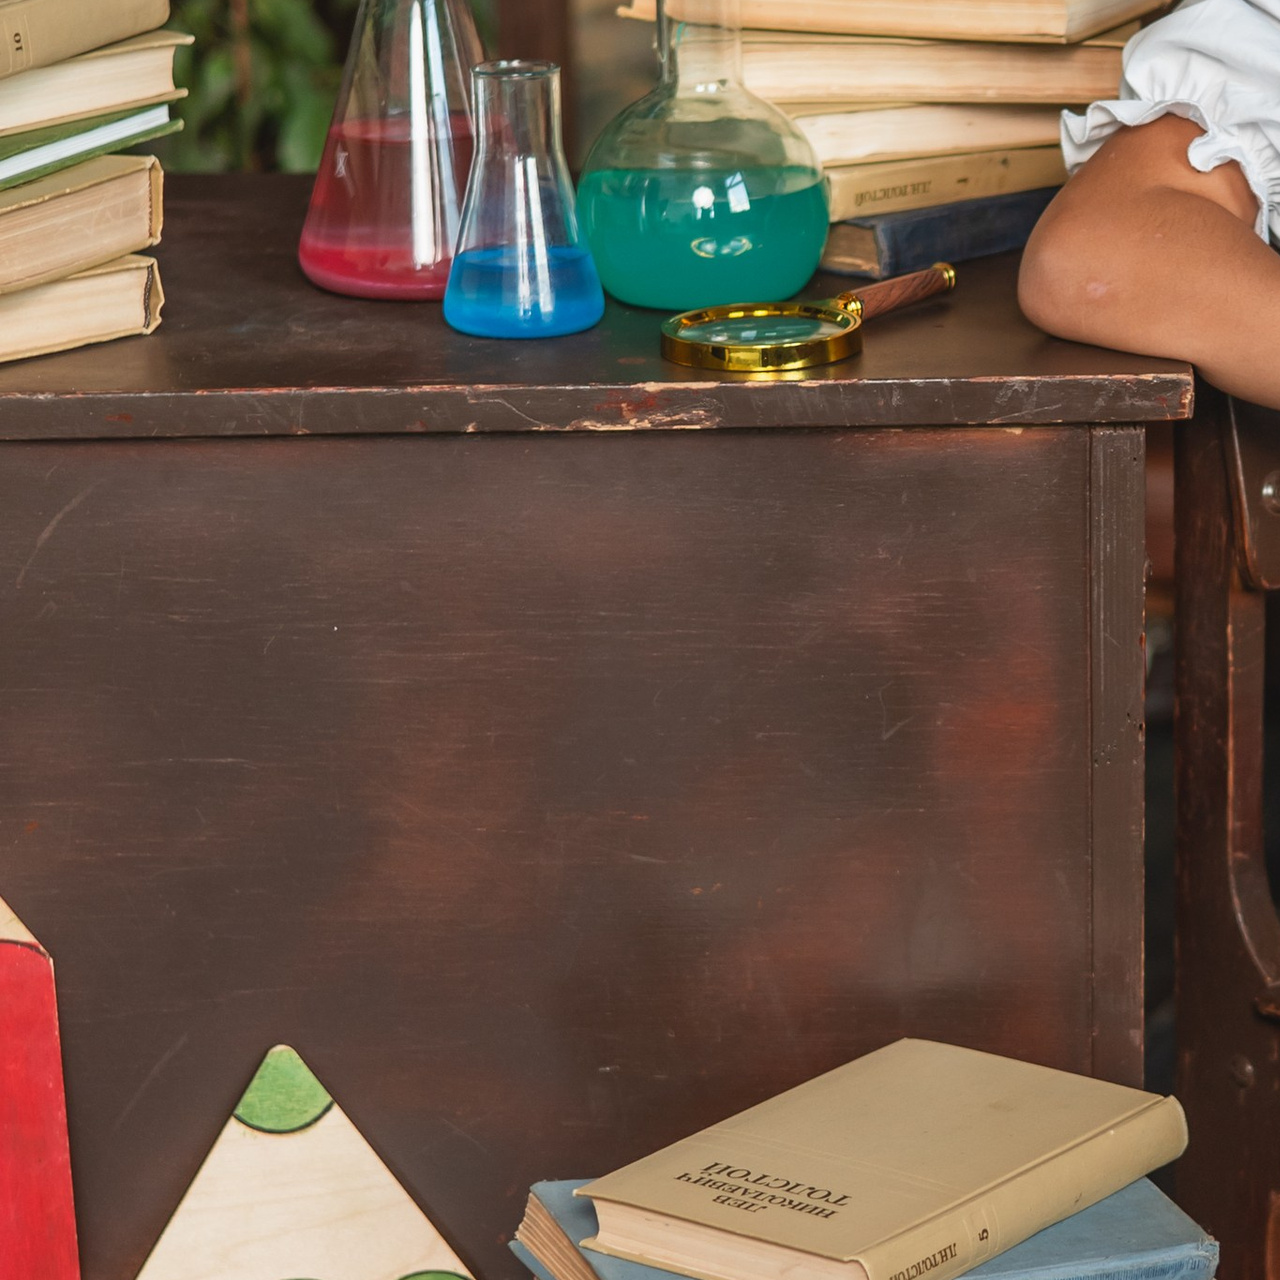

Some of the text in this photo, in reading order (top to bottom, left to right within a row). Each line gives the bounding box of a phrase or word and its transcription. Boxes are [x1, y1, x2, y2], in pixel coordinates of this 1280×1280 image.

[673, 1172, 840, 1219] НИКОЛАЕВИЧ
[699, 1161, 853, 1207] ТОЛСТОЙ
[712, 1194, 768, 1213] ЛЕВ
